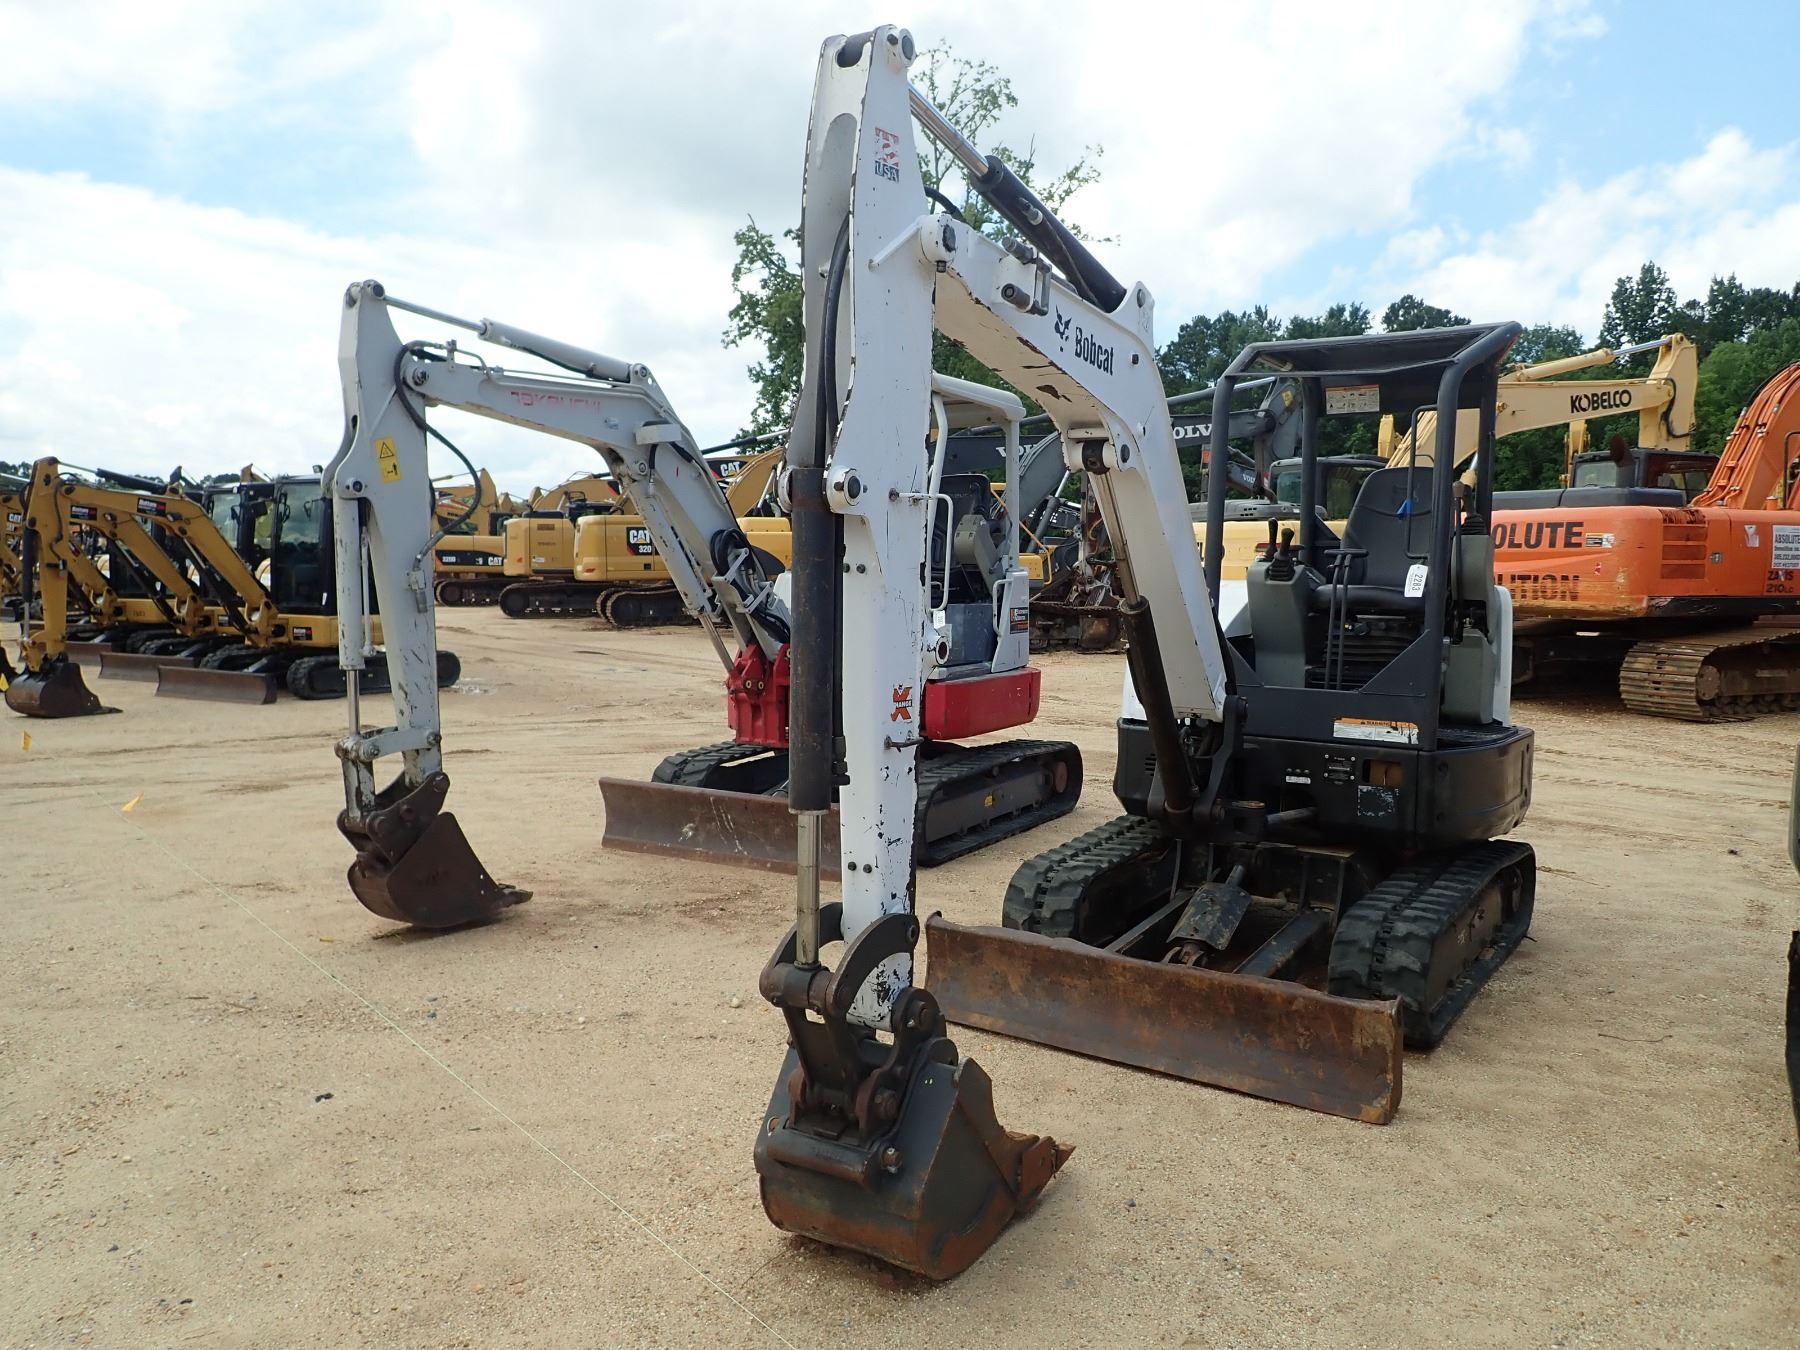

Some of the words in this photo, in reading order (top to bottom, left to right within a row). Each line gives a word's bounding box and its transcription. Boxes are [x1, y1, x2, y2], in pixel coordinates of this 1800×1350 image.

[875, 160, 899, 183] USA
[1075, 326, 1114, 376] Bobcat
[1570, 389, 1632, 413] KOBELCO
[720, 461, 741, 477] CAT
[630, 530, 650, 544] CAT
[1491, 521, 1584, 549] OLUTE
[638, 545, 652, 553] 320
[488, 557, 502, 566] CAT
[1412, 573, 1424, 592] 2283
